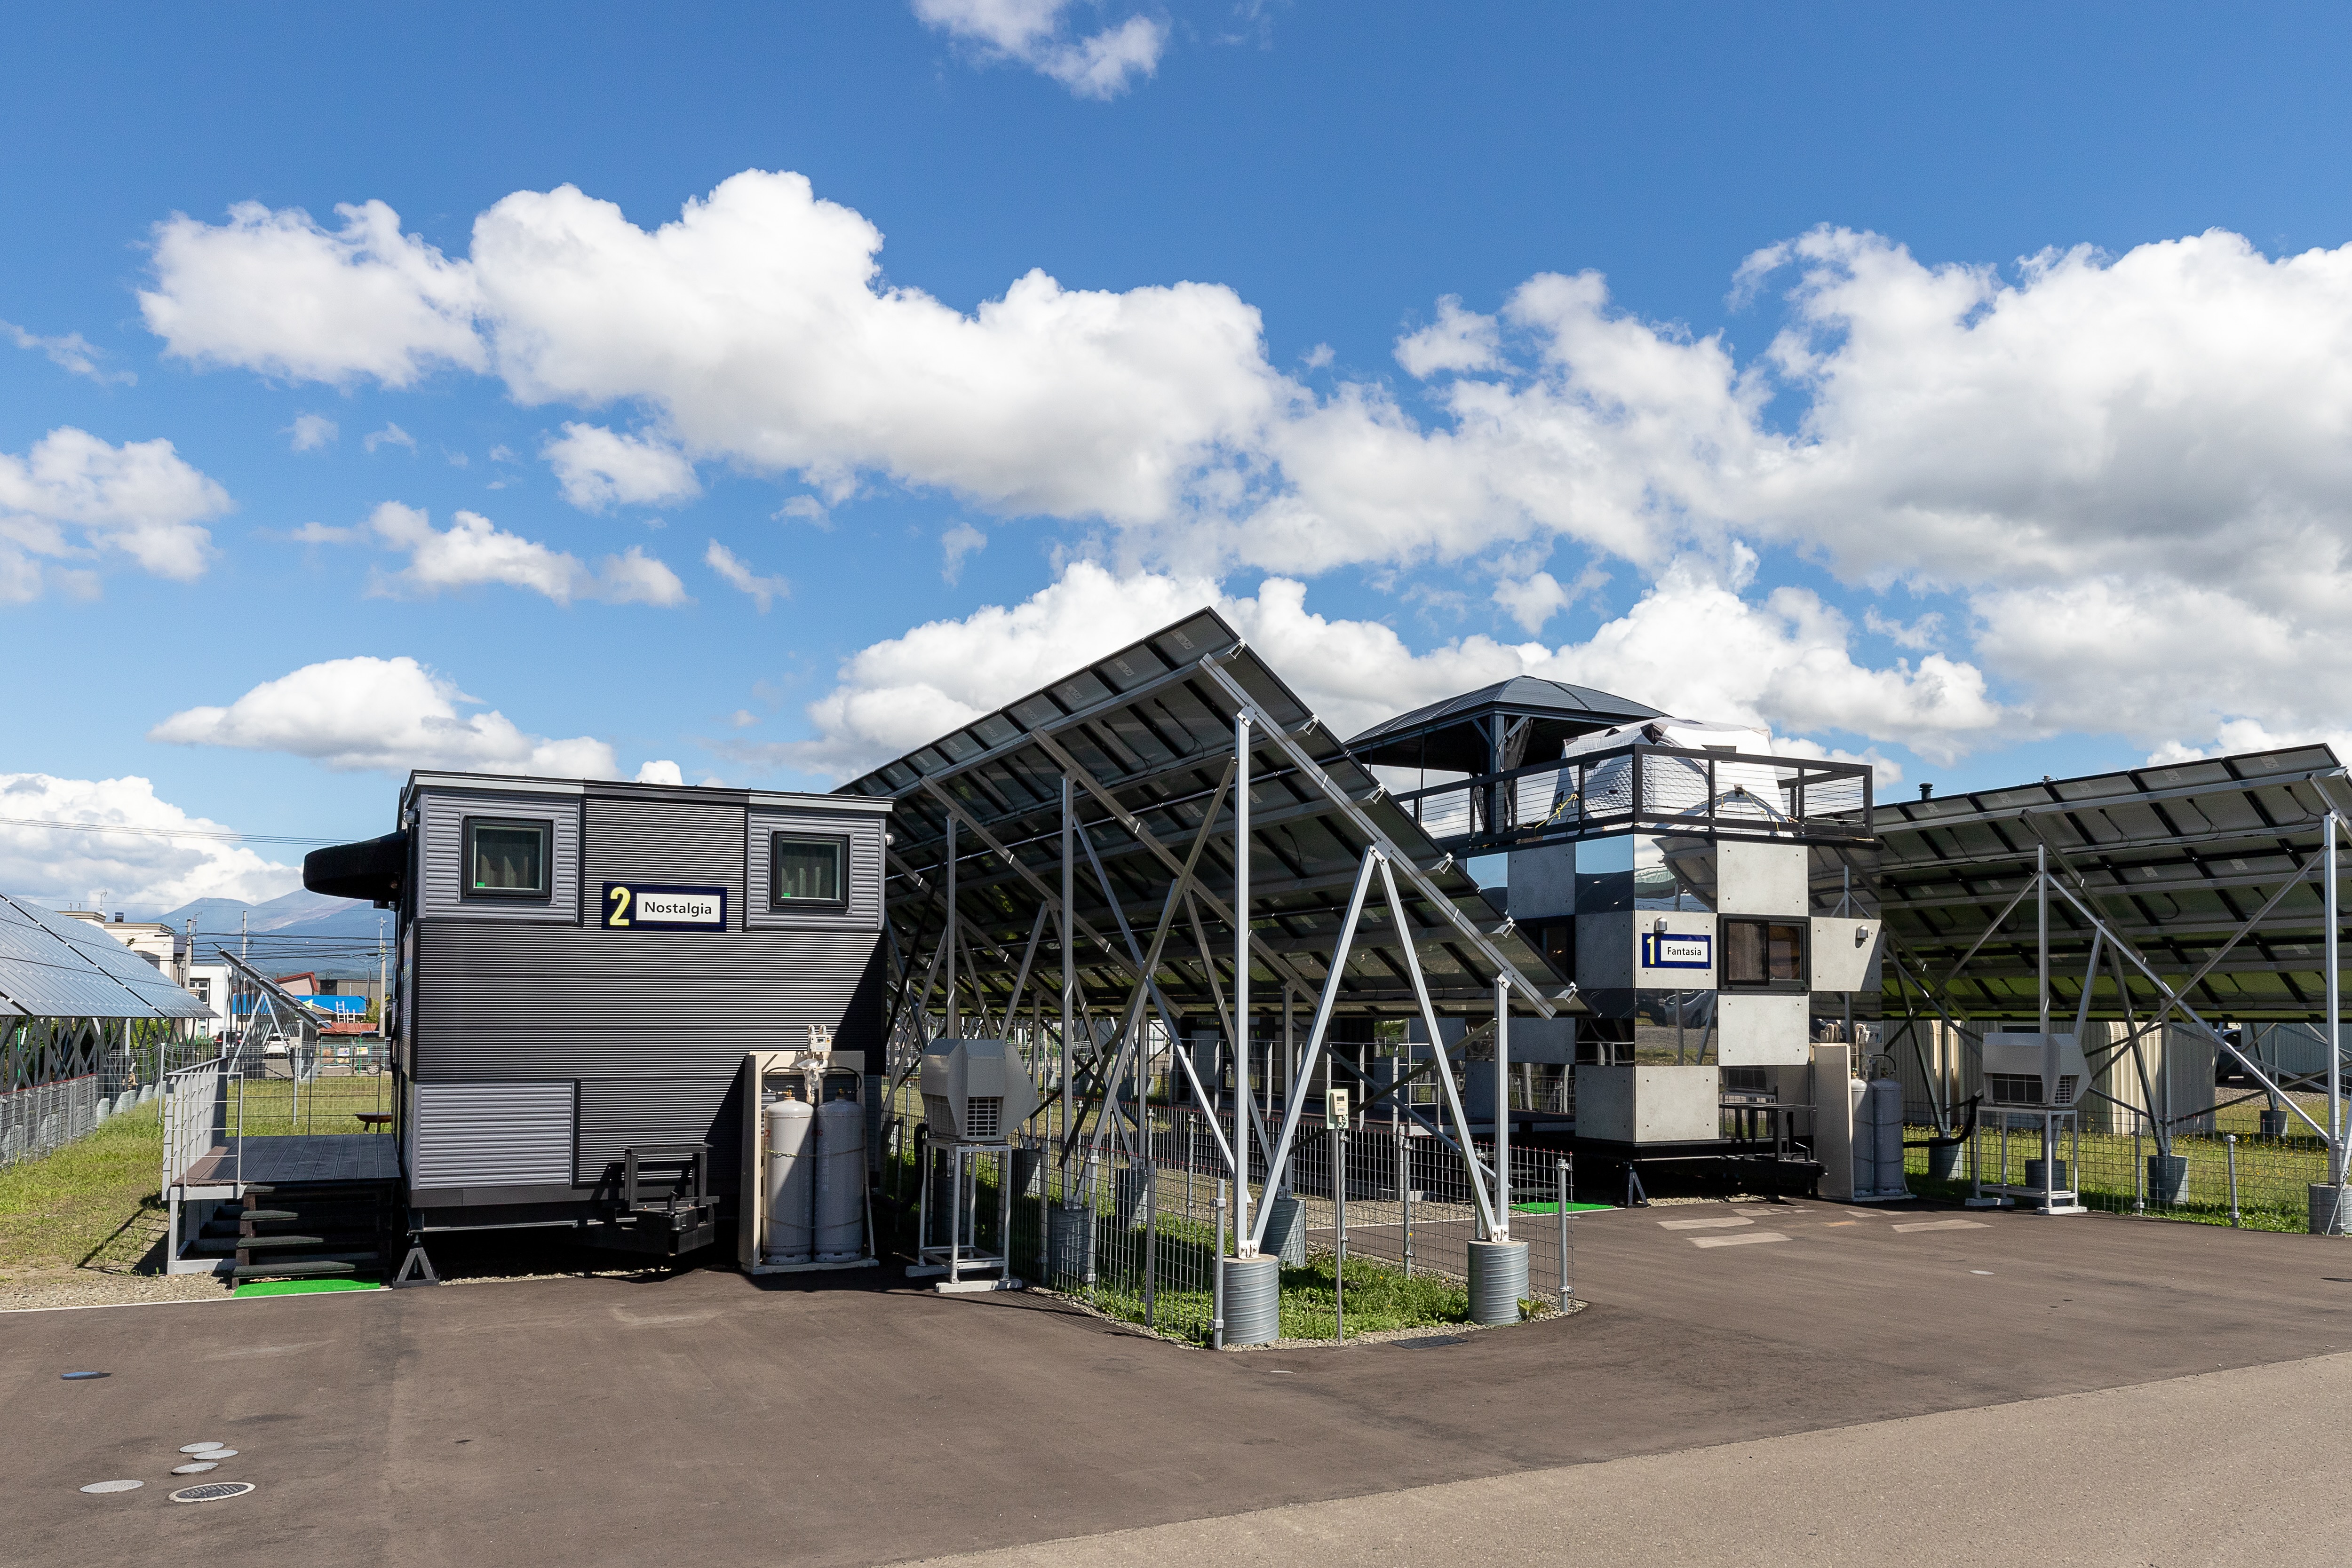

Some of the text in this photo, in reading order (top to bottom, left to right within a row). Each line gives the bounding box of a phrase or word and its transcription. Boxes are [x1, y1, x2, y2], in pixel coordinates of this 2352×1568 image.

[609, 887, 712, 926] 2 Nostalgia
[1647, 936, 1701, 965] 1 Fantasia
